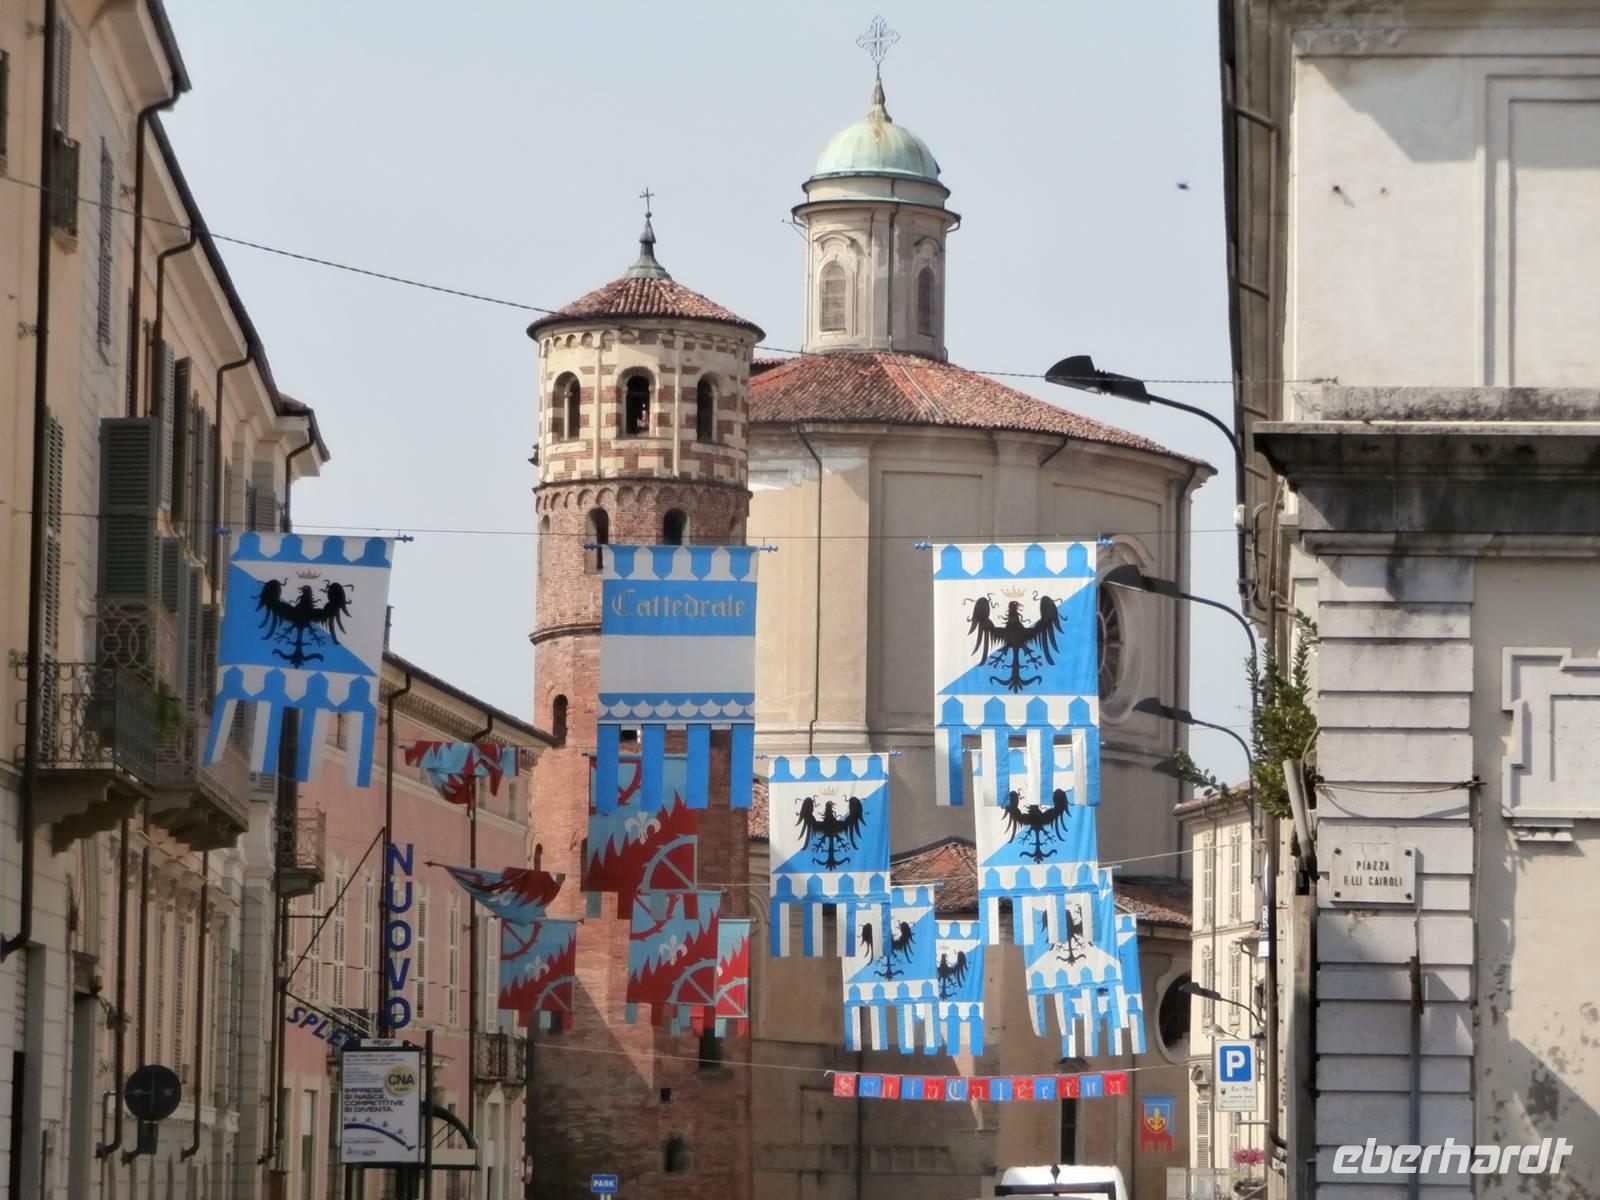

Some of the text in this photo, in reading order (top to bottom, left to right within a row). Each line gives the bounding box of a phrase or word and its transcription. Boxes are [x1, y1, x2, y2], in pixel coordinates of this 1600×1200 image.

[611, 588, 745, 617] Cattedrale
[1356, 861, 1389, 871] PIAZZA
[1368, 876, 1402, 887] CAIROLI
[384, 843, 414, 1029] NUOVO
[286, 1006, 352, 1047] SPLE
[1227, 1050, 1245, 1077] P
[388, 1074, 415, 1085] CNA
[593, 1180, 615, 1188] PARK
